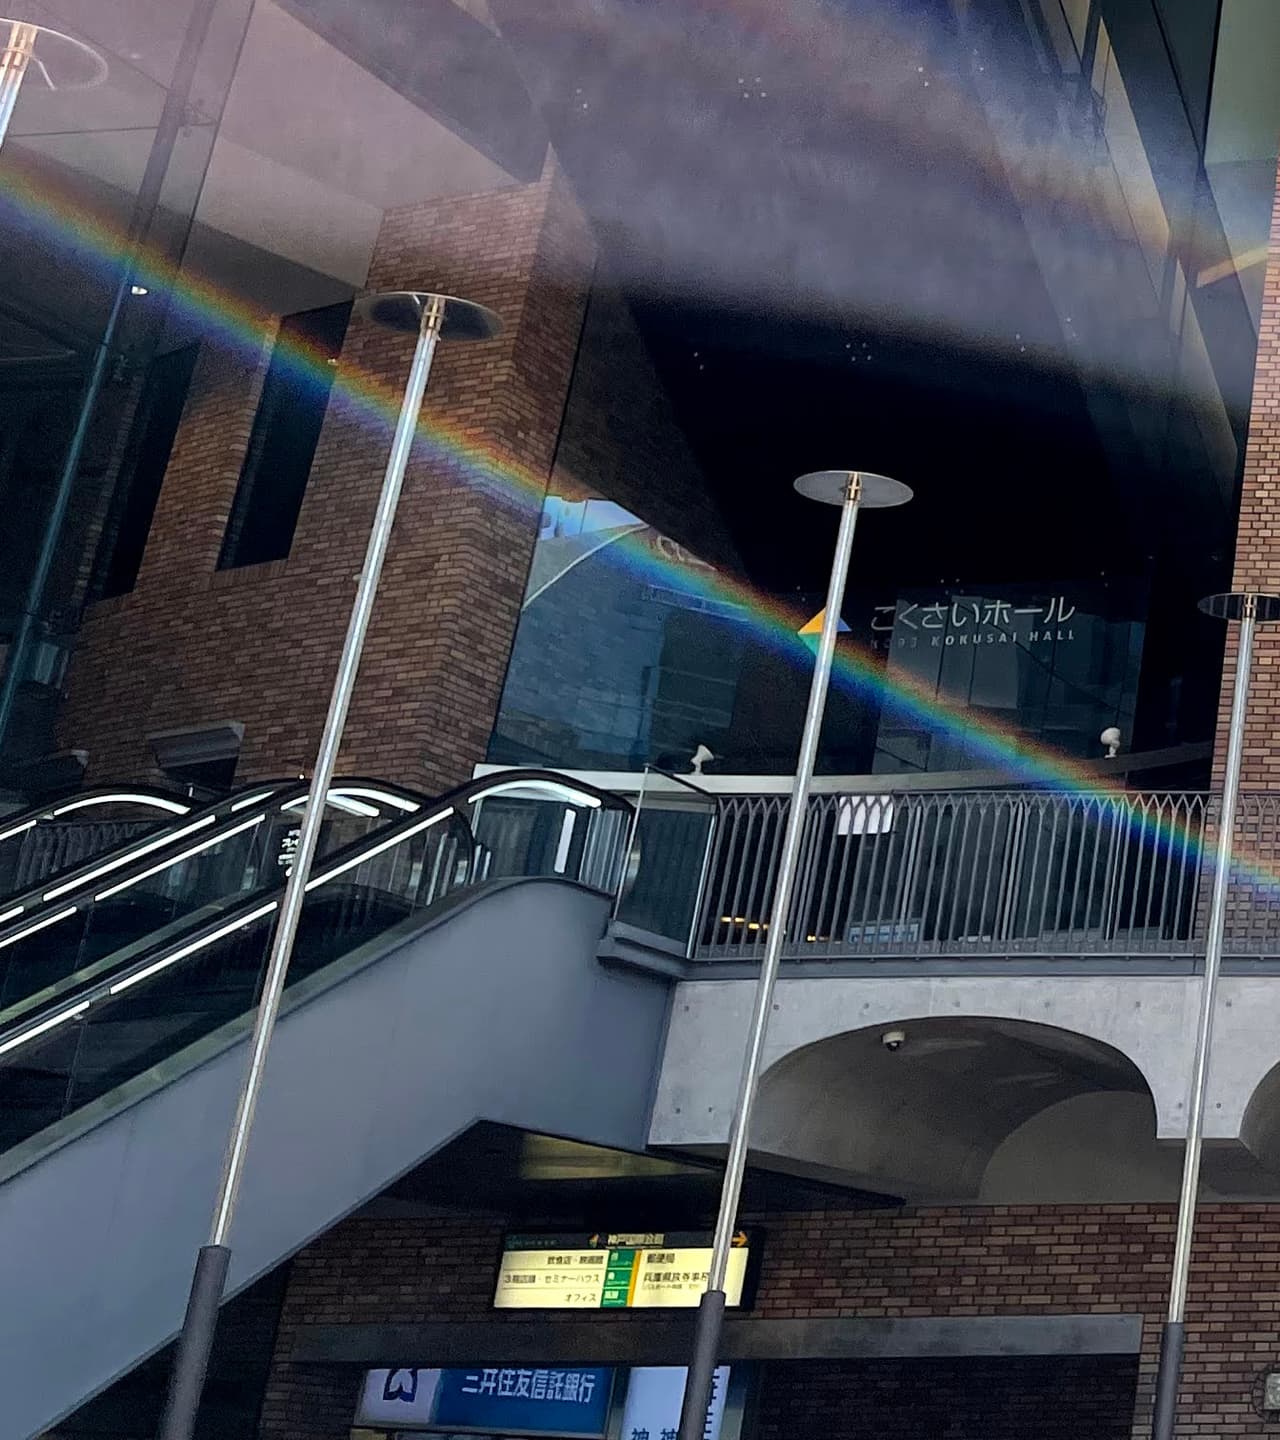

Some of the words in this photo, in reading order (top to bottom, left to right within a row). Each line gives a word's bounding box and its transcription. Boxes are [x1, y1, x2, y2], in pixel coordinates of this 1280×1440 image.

[871, 596, 1076, 632] こくさいホール
[930, 631, 1017, 647] KOKUSAI
[1030, 629, 1075, 642] HALL
